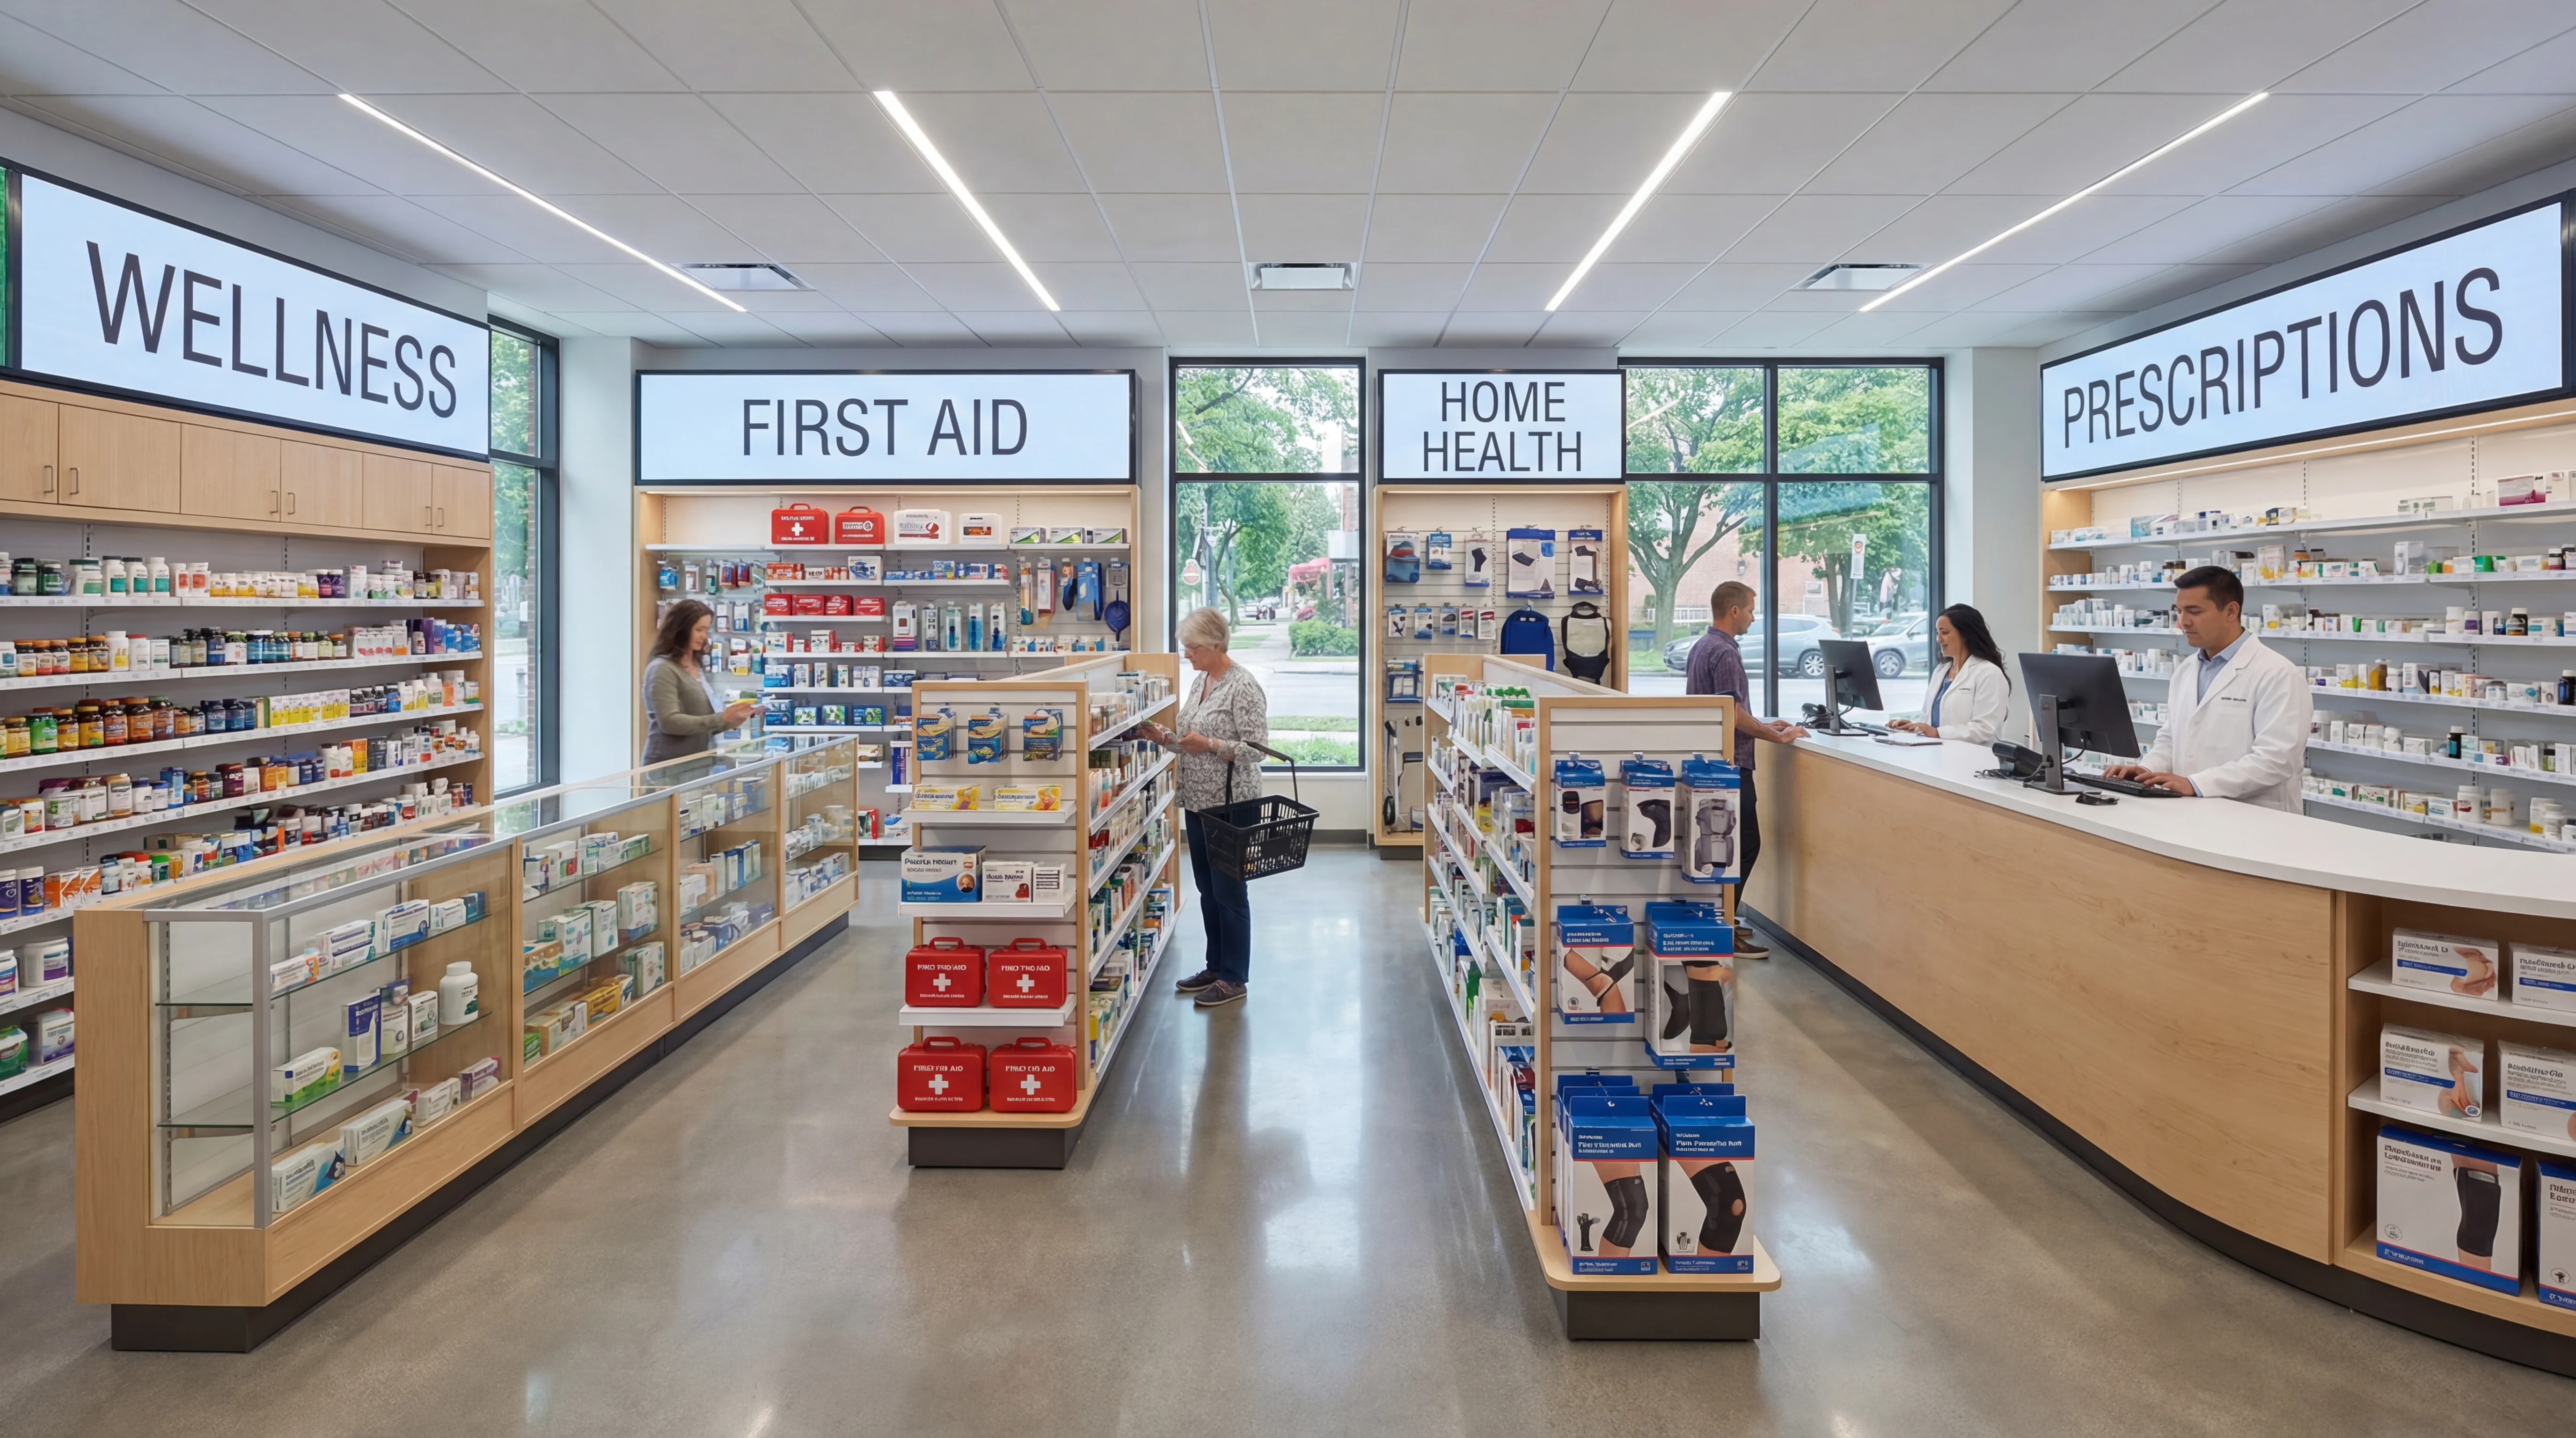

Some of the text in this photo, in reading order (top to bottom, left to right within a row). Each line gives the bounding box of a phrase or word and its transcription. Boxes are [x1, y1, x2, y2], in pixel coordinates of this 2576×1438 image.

[87, 241, 456, 418] WELLNESS
[2064, 268, 2503, 448] PRESCRIPTIONS
[744, 398, 1027, 457] FIRST AID
[1442, 381, 1566, 423] HOME
[1424, 431, 1581, 472] HEALTH
